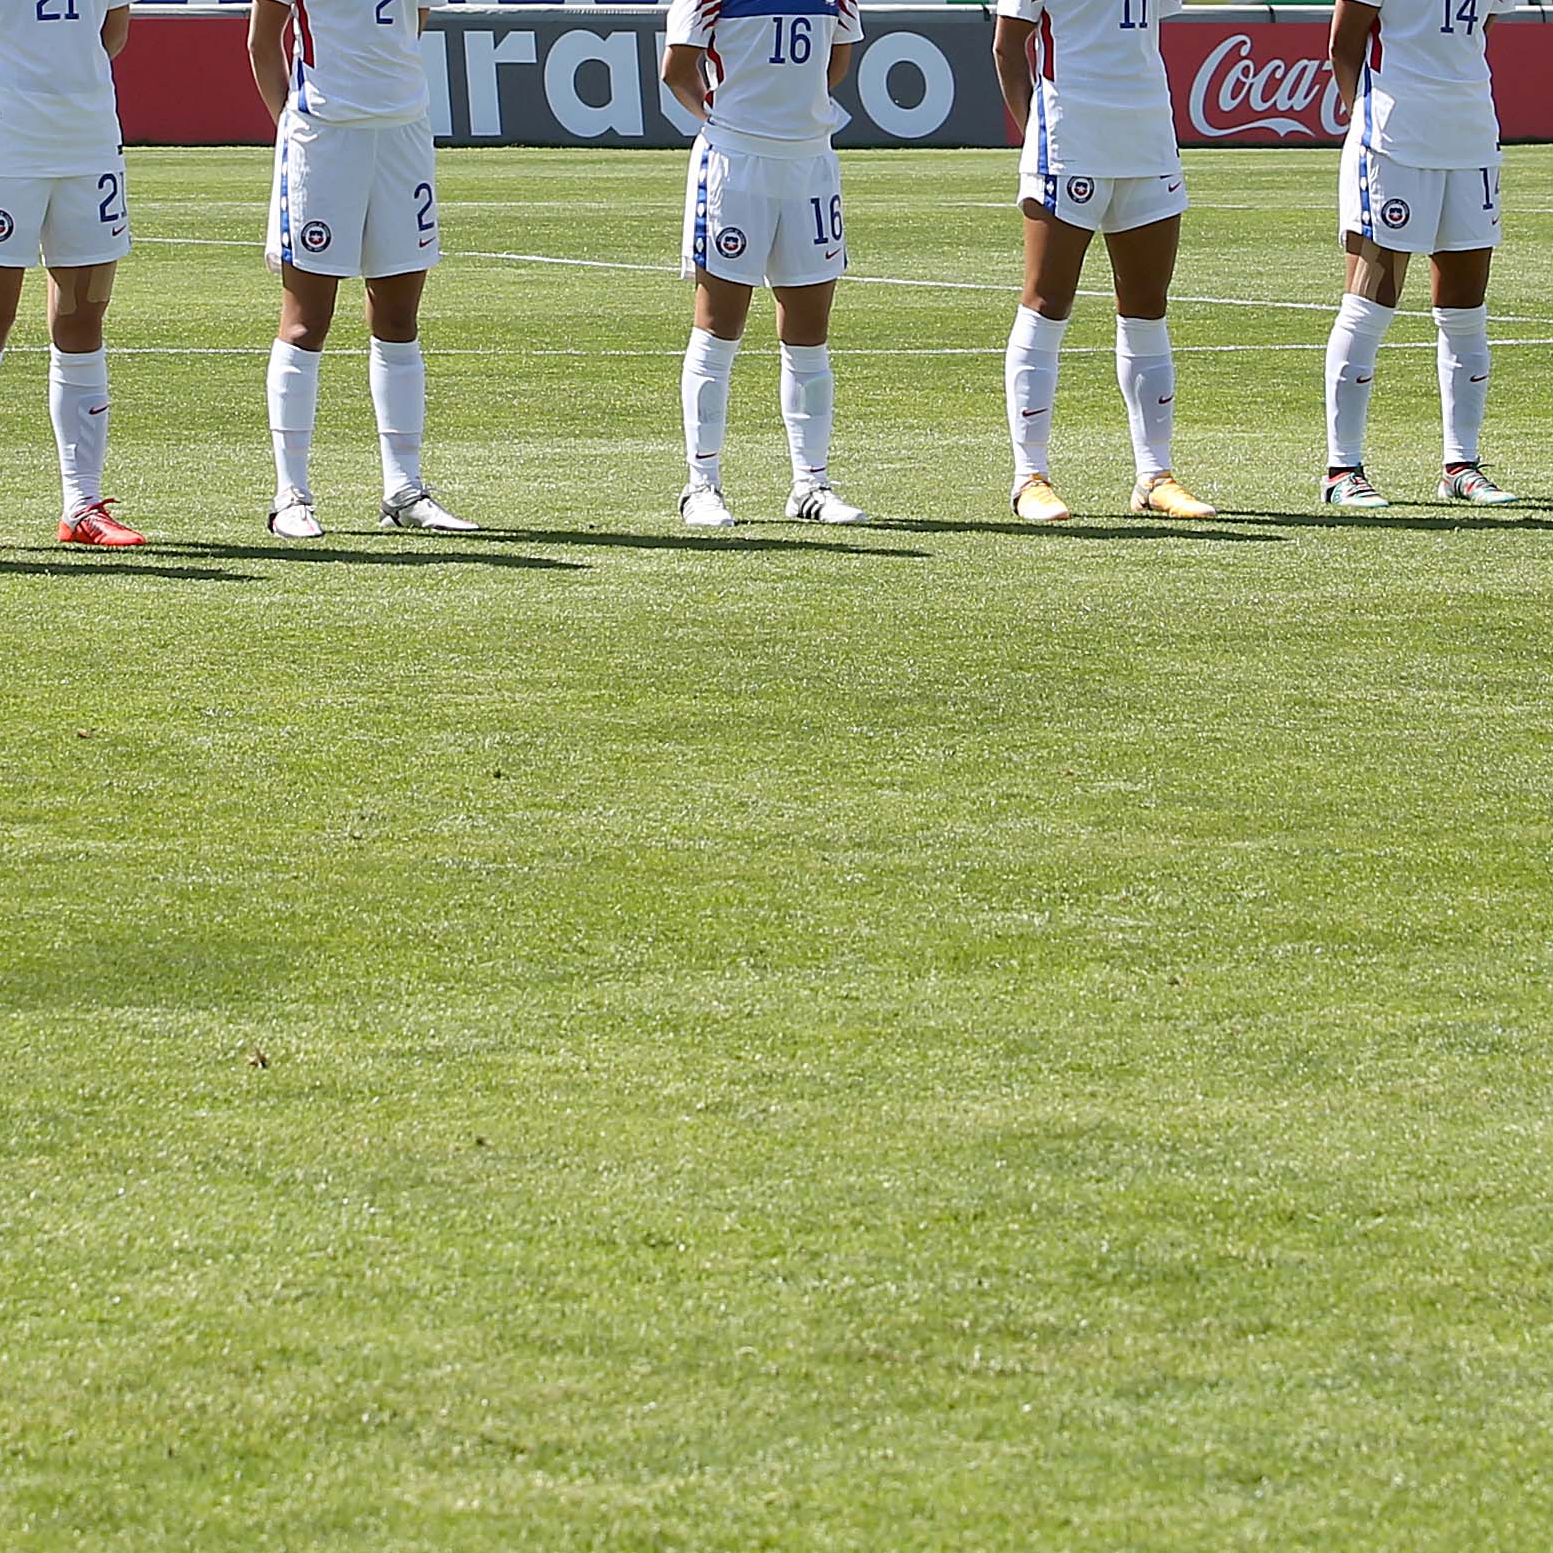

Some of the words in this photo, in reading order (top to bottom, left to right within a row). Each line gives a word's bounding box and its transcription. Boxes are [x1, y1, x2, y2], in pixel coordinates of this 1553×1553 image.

[769, 16, 811, 64] 16
[413, 182, 435, 232] 2
[809, 194, 843, 245] 16
